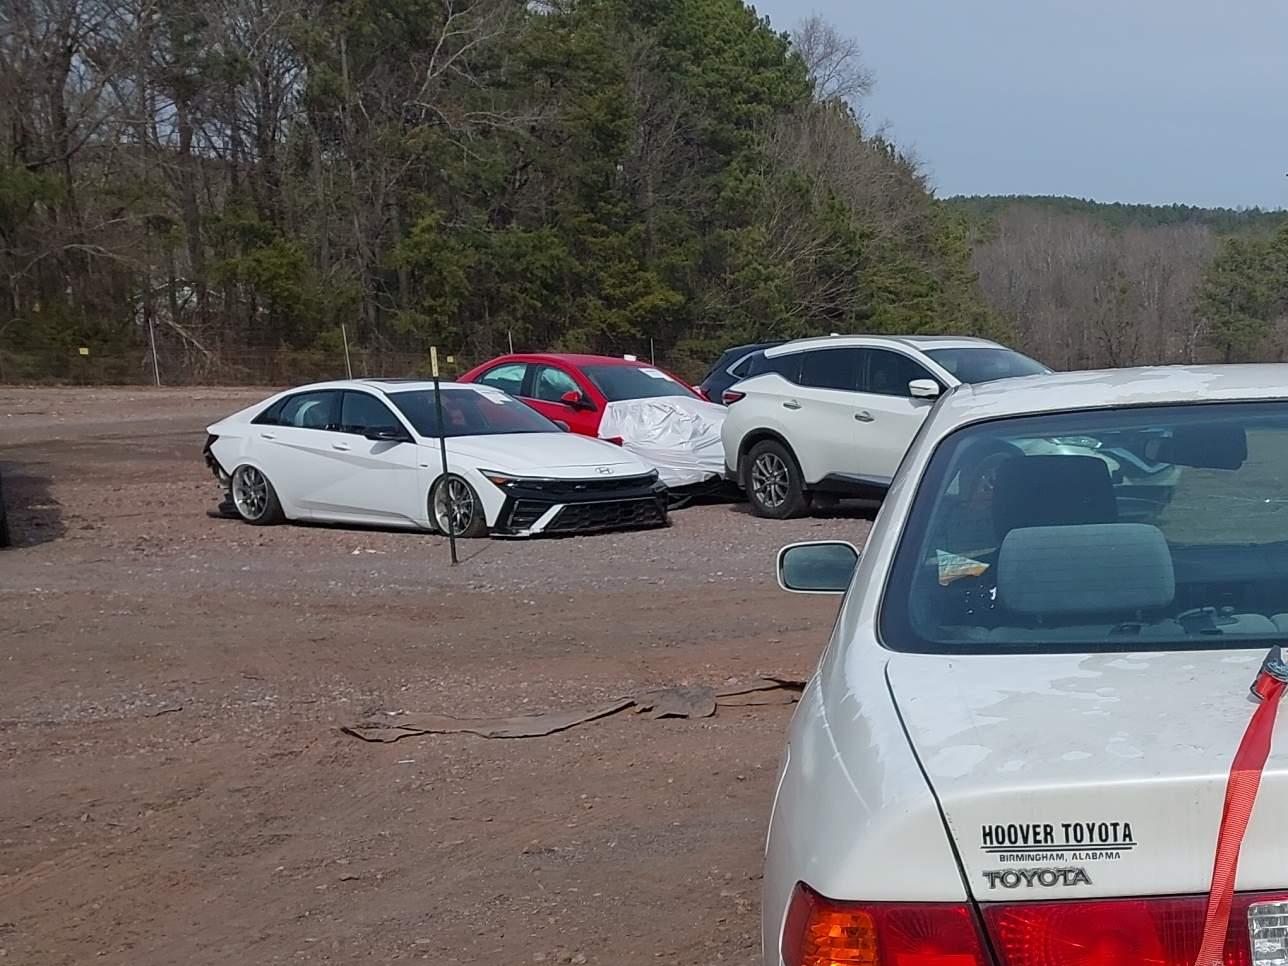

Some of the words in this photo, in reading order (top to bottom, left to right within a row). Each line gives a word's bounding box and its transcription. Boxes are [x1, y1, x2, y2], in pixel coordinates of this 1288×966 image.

[982, 824, 1054, 845] HOOVER
[1061, 822, 1133, 843] TOYOTA
[1000, 853, 1068, 862] BIRMINGHAM,
[1071, 852, 1121, 861] ALABAMA
[982, 867, 1092, 889] TOYOTA
